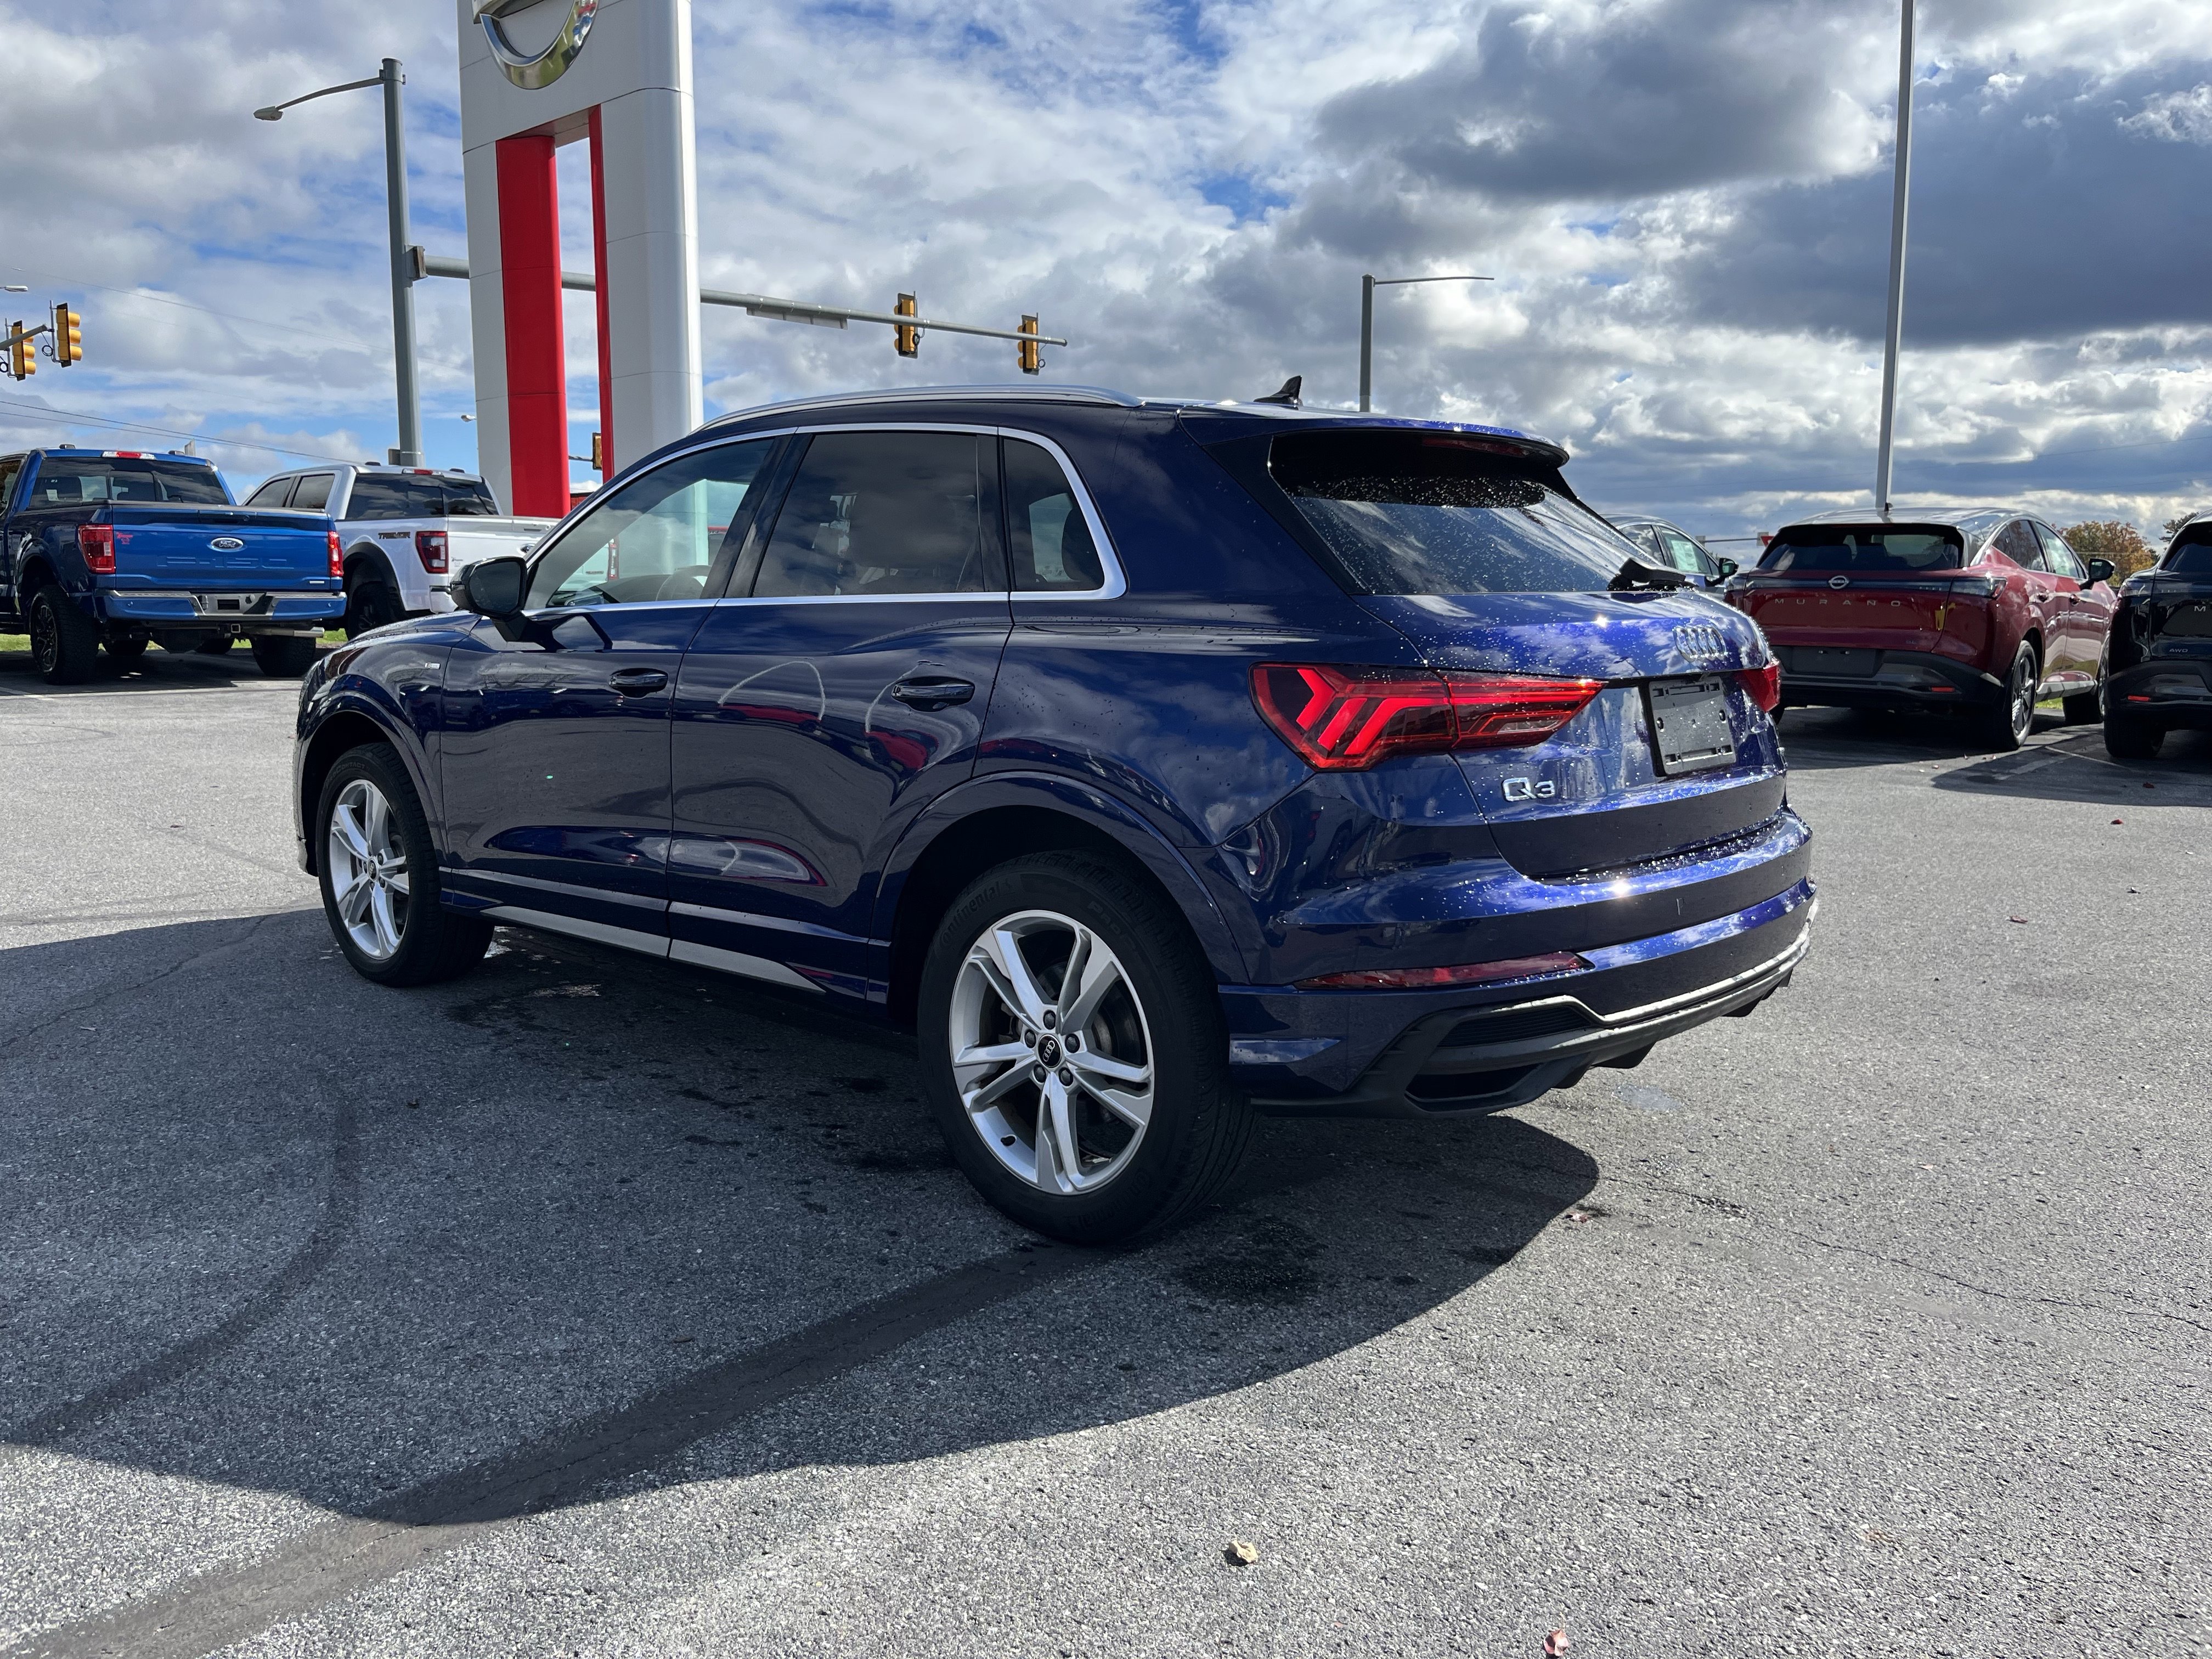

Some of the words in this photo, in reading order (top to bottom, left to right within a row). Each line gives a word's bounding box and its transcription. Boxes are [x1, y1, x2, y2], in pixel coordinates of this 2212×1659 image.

[1774, 598, 1901, 607] MURANO
[1502, 776, 1556, 802] Q3
[938, 880, 1002, 950] Continental
